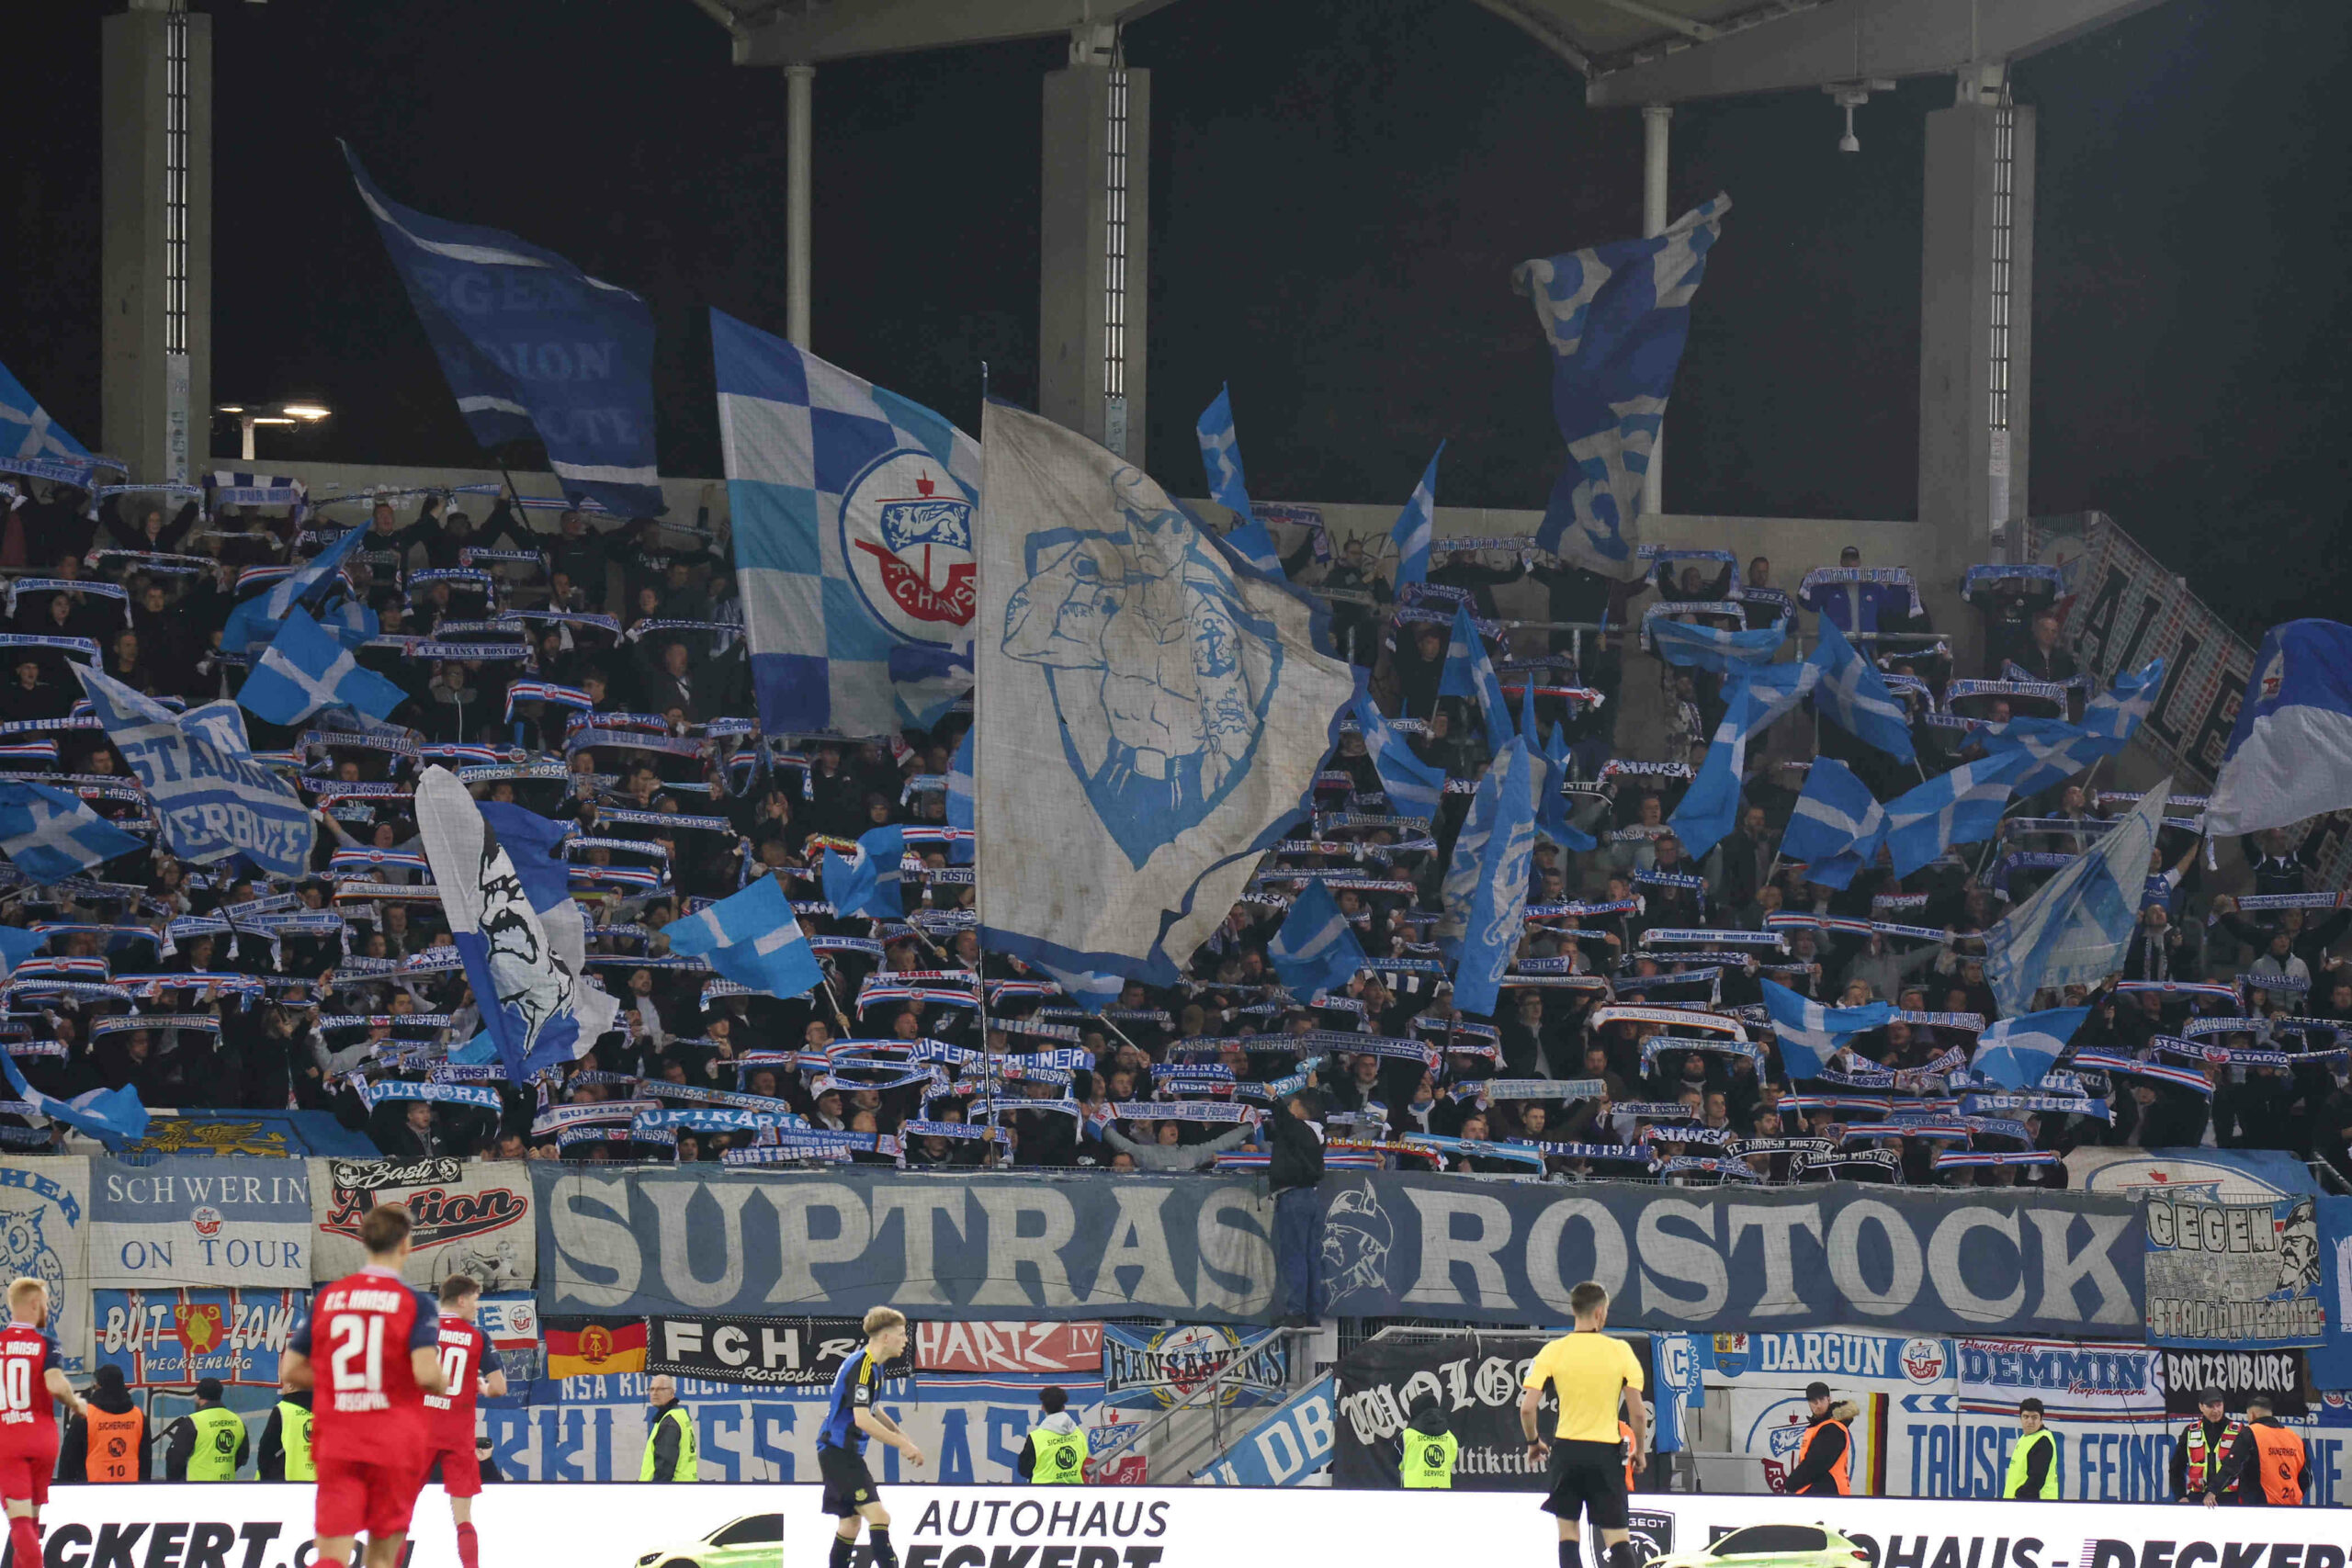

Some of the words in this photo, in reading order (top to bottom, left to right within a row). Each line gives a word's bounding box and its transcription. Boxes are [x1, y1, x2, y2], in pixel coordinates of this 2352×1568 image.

[445, 646, 481, 656] HANSA
[1519, 958, 1566, 971] ROSTOCK
[453, 1066, 491, 1079] HANSA
[1851, 1071, 1893, 1087] ROSTOCK
[1151, 1104, 1177, 1115] FEINDE
[1975, 1094, 2092, 1112] ROSTOCK
[1727, 1143, 1741, 1156] FC
[1746, 1139, 1785, 1150] HANSA
[1789, 1139, 1837, 1156] ROSTOCK
[357, 1158, 435, 1190] Basti
[107, 1174, 308, 1204] SCHWERIN
[331, 1189, 526, 1227] Ation
[2147, 1198, 2277, 1254] GEGEN
[120, 1239, 173, 1270] ON
[198, 1238, 302, 1269] TOUR
[551, 1174, 1278, 1317] SUPTRAS
[1402, 1186, 2142, 1325] ROSTOCK
[348, 1289, 401, 1314] HANSA
[437, 1328, 473, 1348] HANSA
[663, 1320, 800, 1370] FCH
[330, 1314, 386, 1393] 21
[1759, 1333, 1888, 1376] DARGUN
[144, 1357, 253, 1372] MECKLENBURG
[1962, 1348, 2150, 1391] DEMMIN
[742, 1365, 817, 1384] Rostock
[2067, 1380, 2148, 1399] Vorpommern
[97, 1420, 136, 1431] SICHERHEIT
[1417, 1434, 1450, 1442] SICHERHEIT
[107, 1463, 126, 1478] 10
[1423, 1469, 1445, 1478] SERVICE
[913, 1499, 1170, 1538] AUTOHAUS
